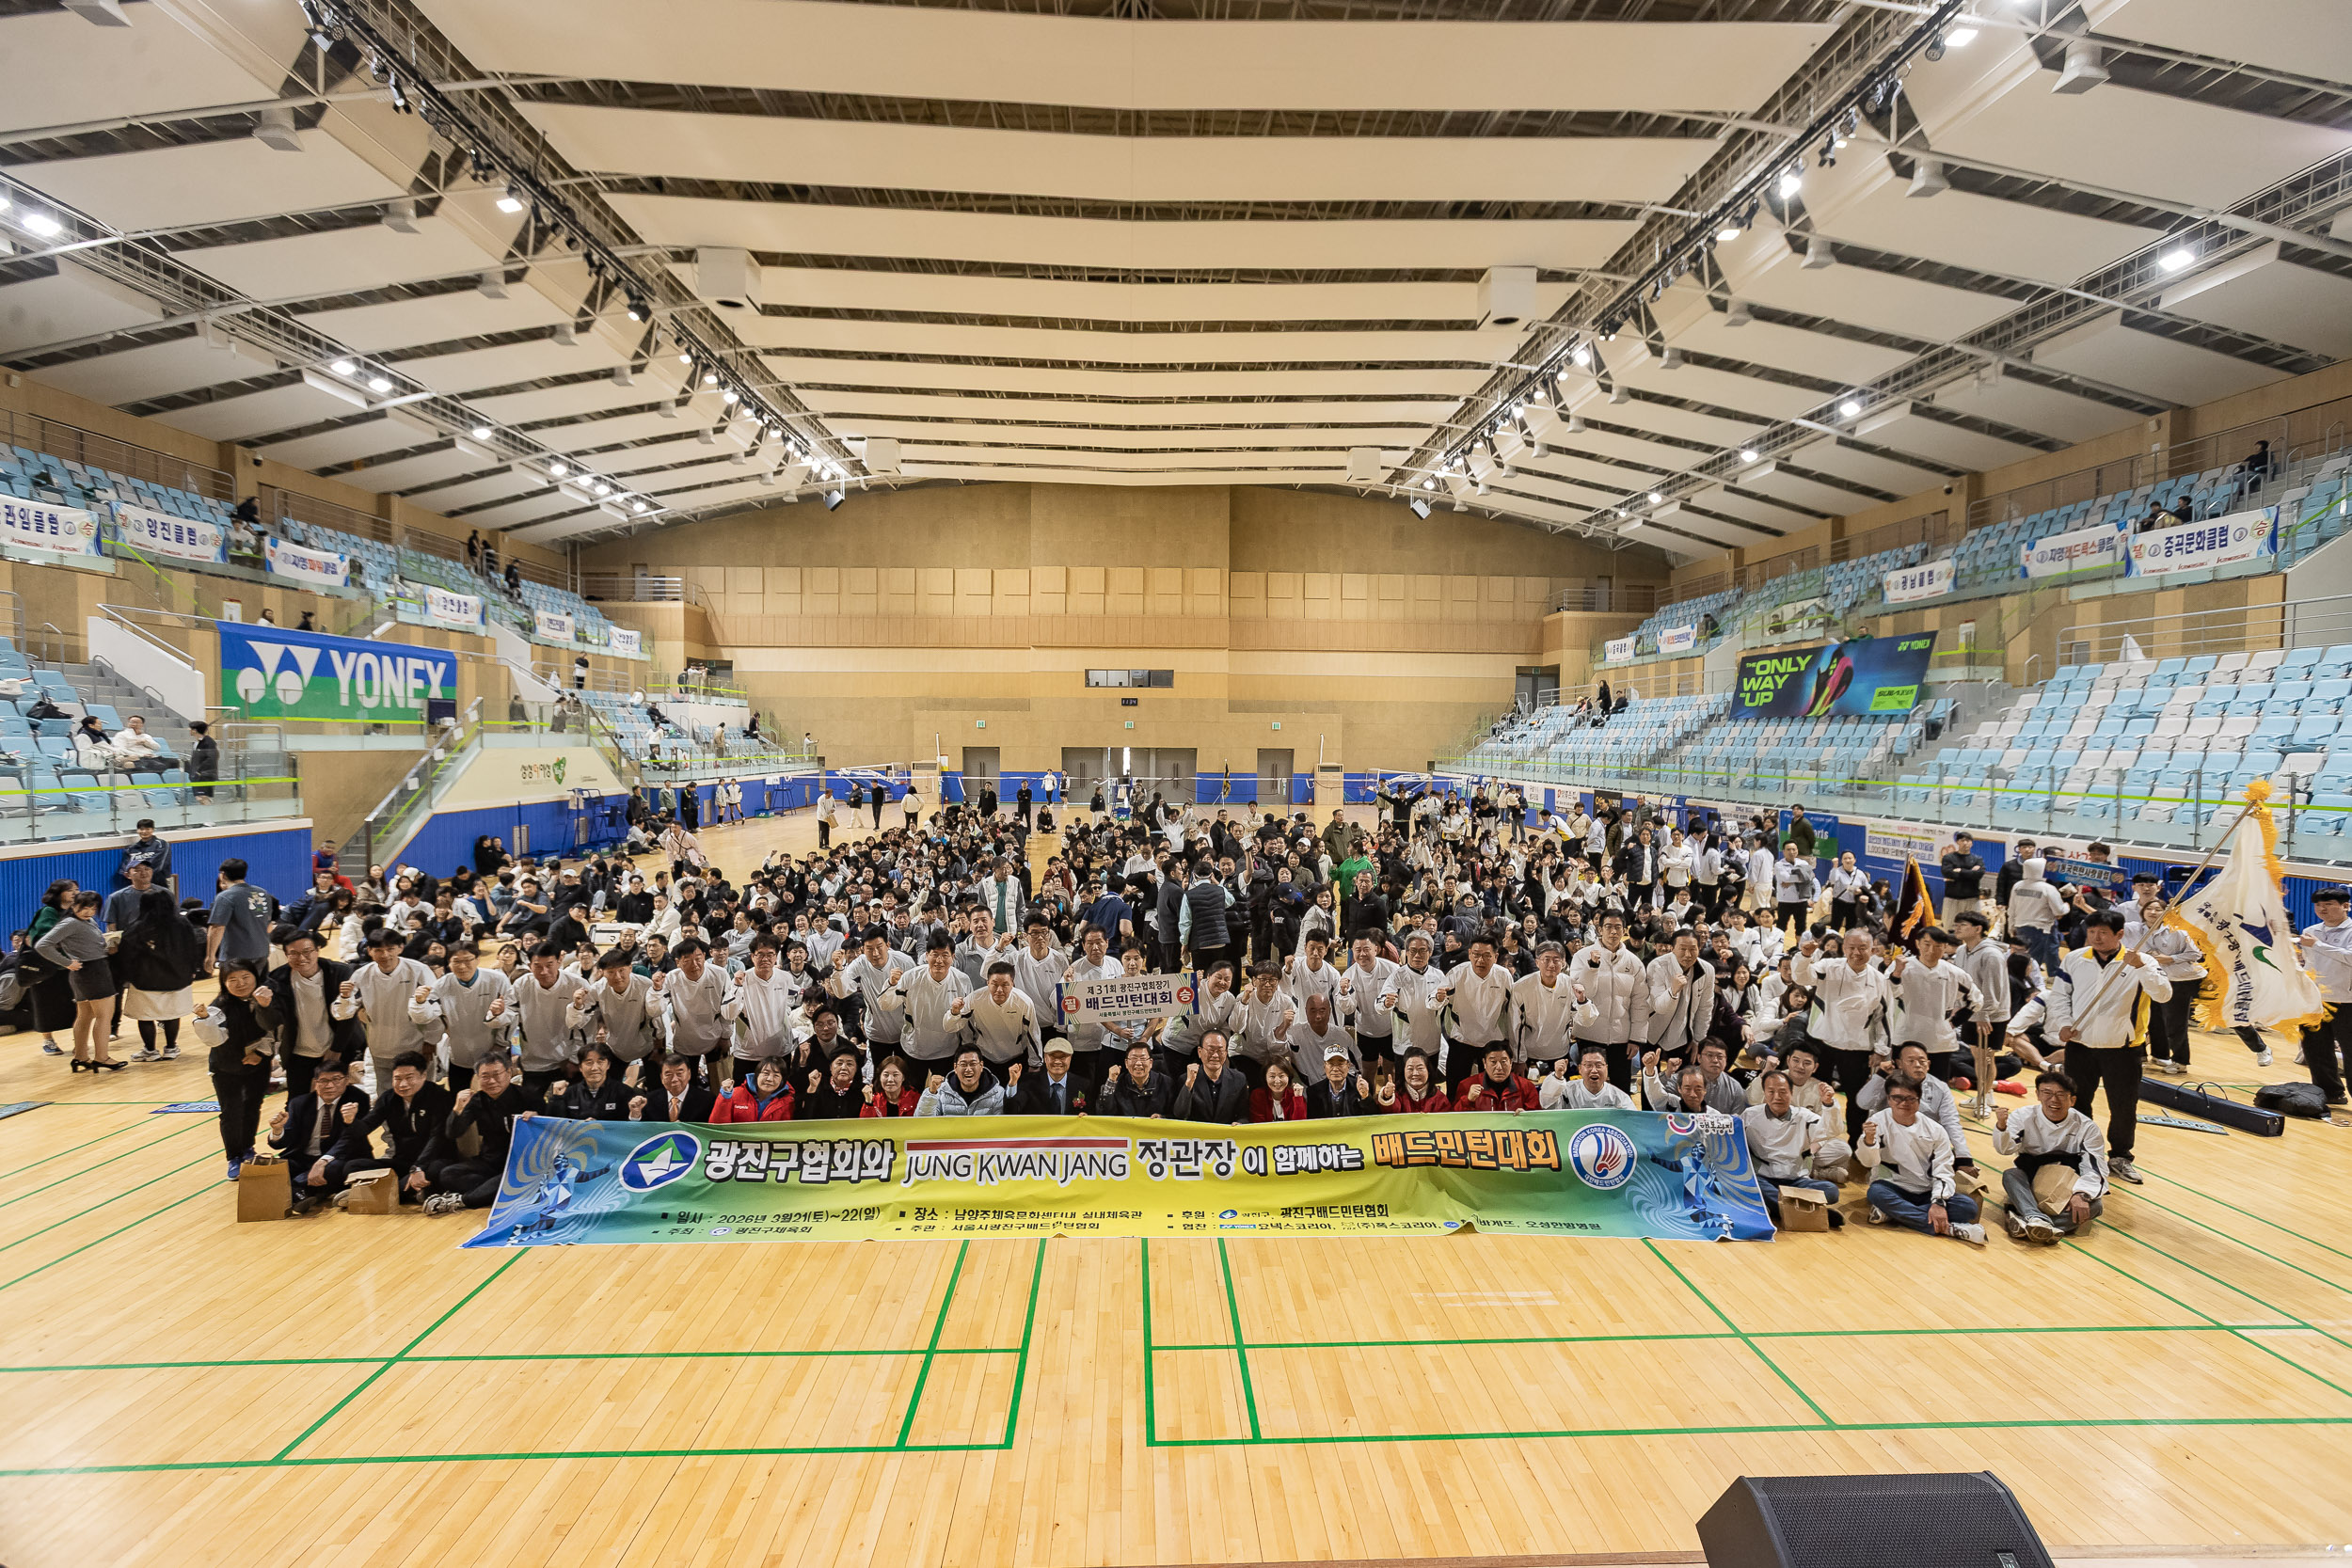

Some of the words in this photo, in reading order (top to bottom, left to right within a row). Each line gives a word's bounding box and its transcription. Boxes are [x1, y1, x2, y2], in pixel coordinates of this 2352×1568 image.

[0, 504, 59, 535] 라임클럽
[2253, 518, 2268, 536] 승
[147, 517, 198, 546] 양진클럽
[2164, 524, 2230, 558] 중곡문화클럽
[1755, 655, 1813, 675] ONLY
[330, 650, 447, 709] YONEX
[1742, 674, 1789, 691] WAY
[1744, 691, 1774, 707] UP
[1087, 984, 1117, 995] 제31회
[1120, 980, 1170, 993] 광진구협회장기
[1179, 989, 1191, 1001] 승
[1064, 998, 1077, 1011] 필
[1086, 990, 1173, 1011] 배드민턴대회
[1699, 1121, 1733, 1133] 행복광진
[1607, 1128, 1633, 1159] ASSOCIATION
[705, 1139, 896, 1183] 광진구협회와
[1137, 1140, 1237, 1178] 정관장
[1244, 1147, 1266, 1175] 이
[1274, 1145, 1363, 1174] 함께하는
[1372, 1130, 1562, 1172] 배드민턴대회
[903, 1154, 971, 1183] JUNG
[1060, 1154, 1127, 1183] JANG
[676, 1211, 704, 1224] 일시
[719, 1213, 767, 1224] 2026년
[914, 1207, 939, 1221] 장소
[1082, 1211, 1143, 1221] 실내체육관
[1182, 1210, 1206, 1220] 후원
[1280, 1204, 1390, 1220] 광진구배드민턴협회
[667, 1227, 694, 1236] 주최
[735, 1226, 814, 1235] 광진구체육회
